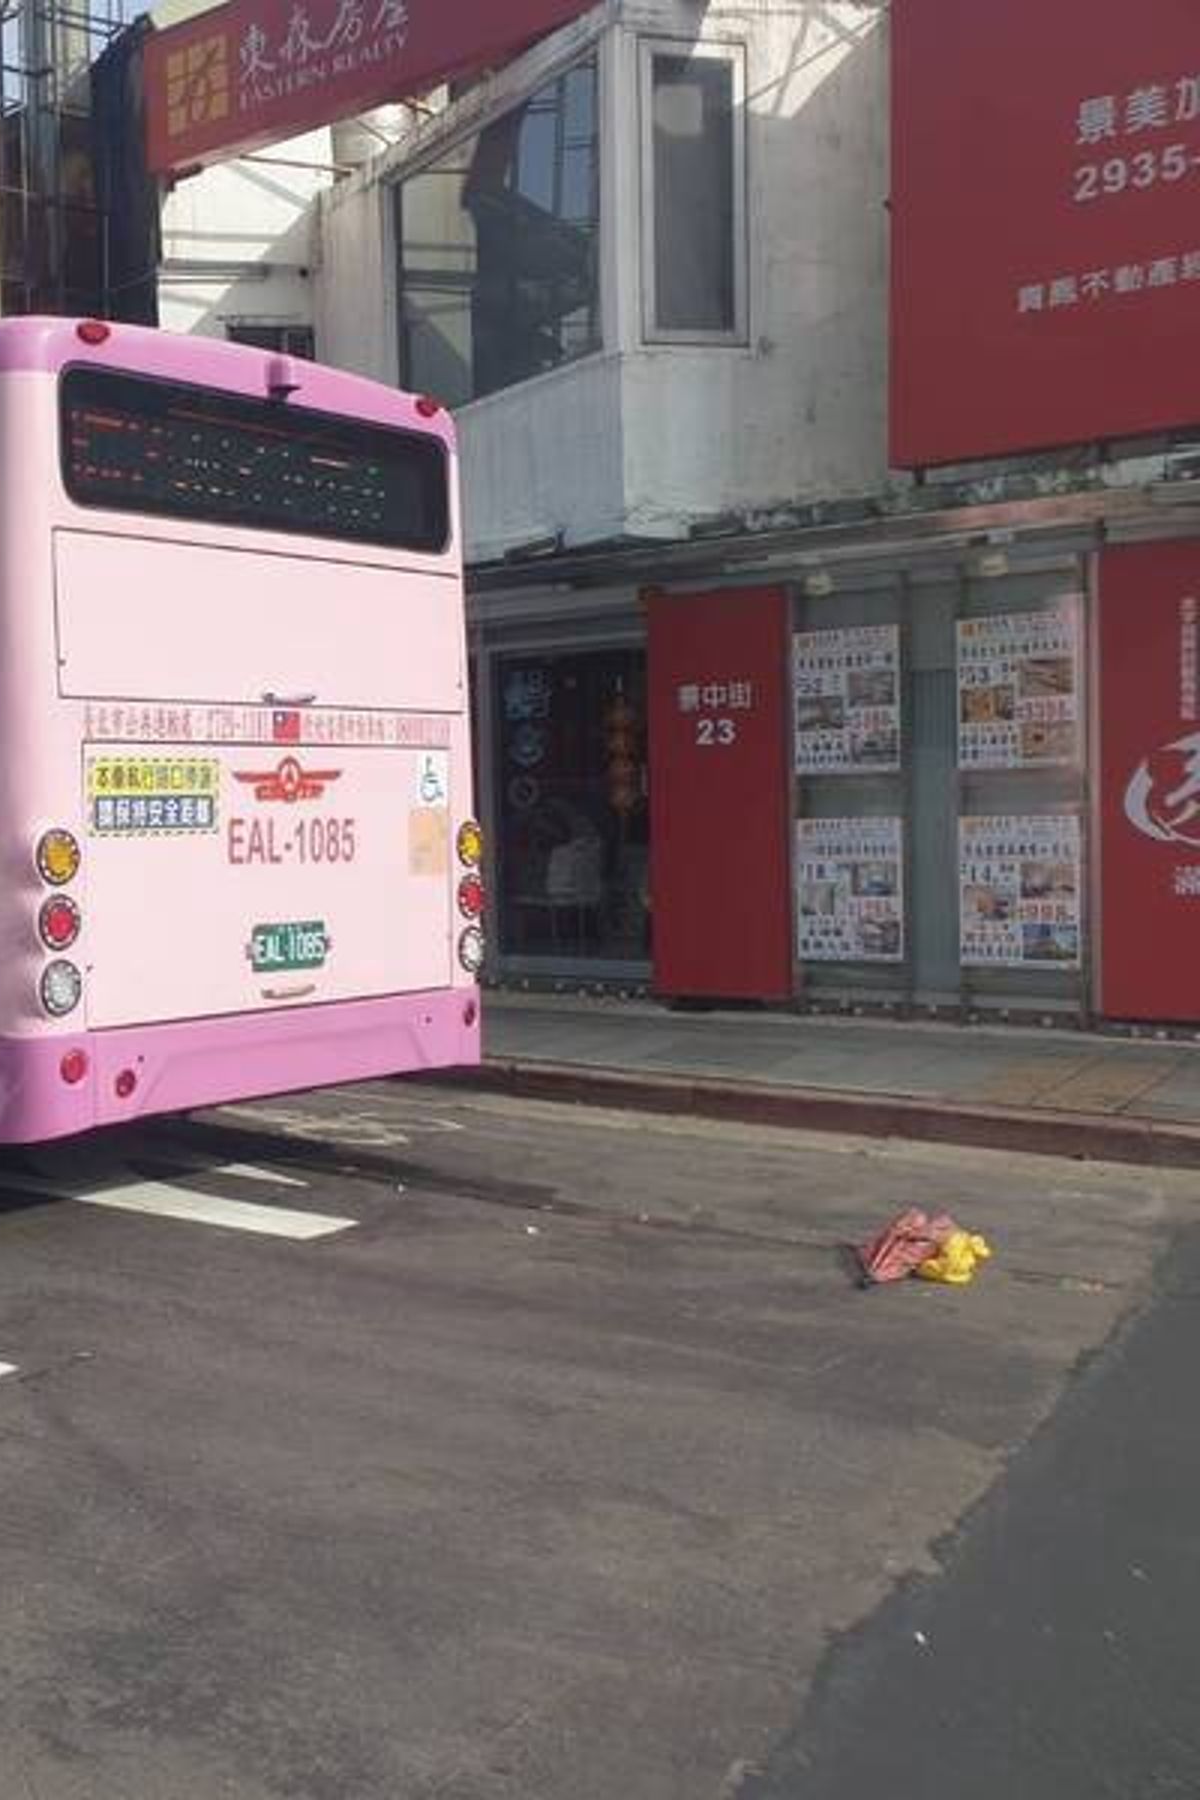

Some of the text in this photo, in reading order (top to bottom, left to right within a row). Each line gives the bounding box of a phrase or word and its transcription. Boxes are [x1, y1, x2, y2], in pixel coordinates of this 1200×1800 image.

[695, 719, 737, 746] 23
[228, 818, 356, 865] EAL-1085
[255, 931, 326, 962] EAL-1085
